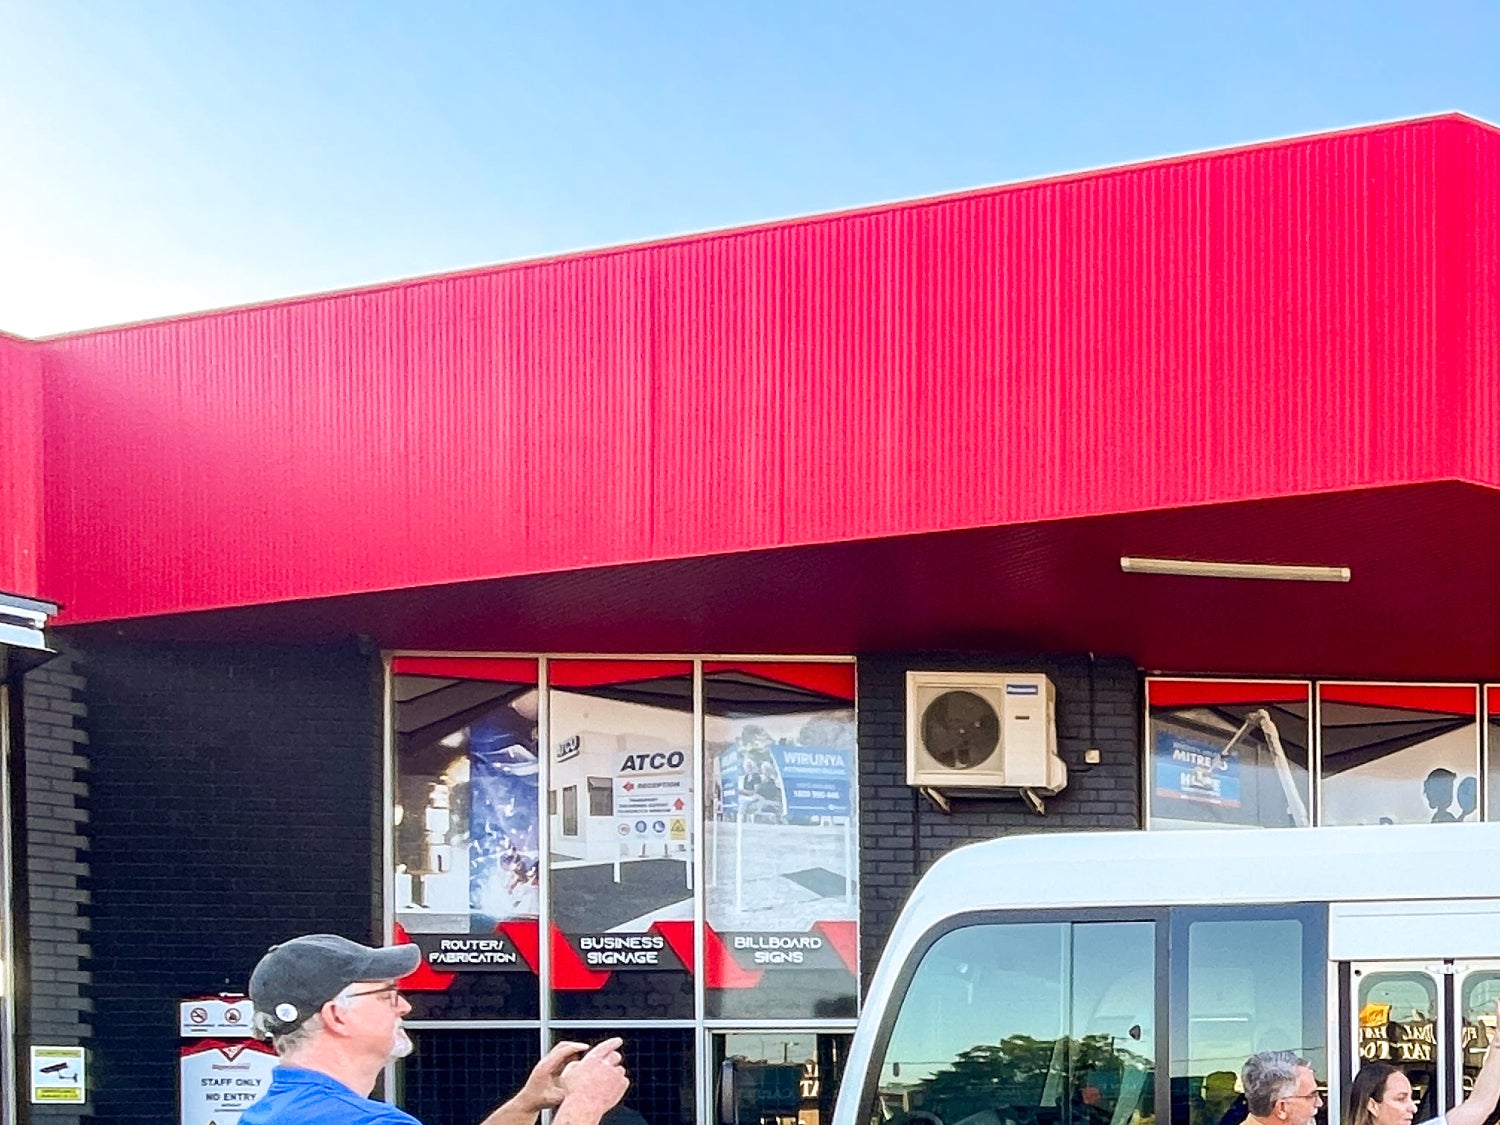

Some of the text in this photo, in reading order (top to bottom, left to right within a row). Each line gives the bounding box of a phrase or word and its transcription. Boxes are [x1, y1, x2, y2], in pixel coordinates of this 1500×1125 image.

[620, 751, 685, 772] ATCO
[580, 936, 664, 950] BUSINESS
[733, 936, 822, 950] BILLBOARD
[428, 952, 517, 964] FABRICATION
[587, 951, 659, 965] SIGNAGE
[754, 951, 804, 964] SIGNS
[201, 1078, 262, 1087] STAFF ONLY
[206, 1093, 257, 1101] NO ENTRY
